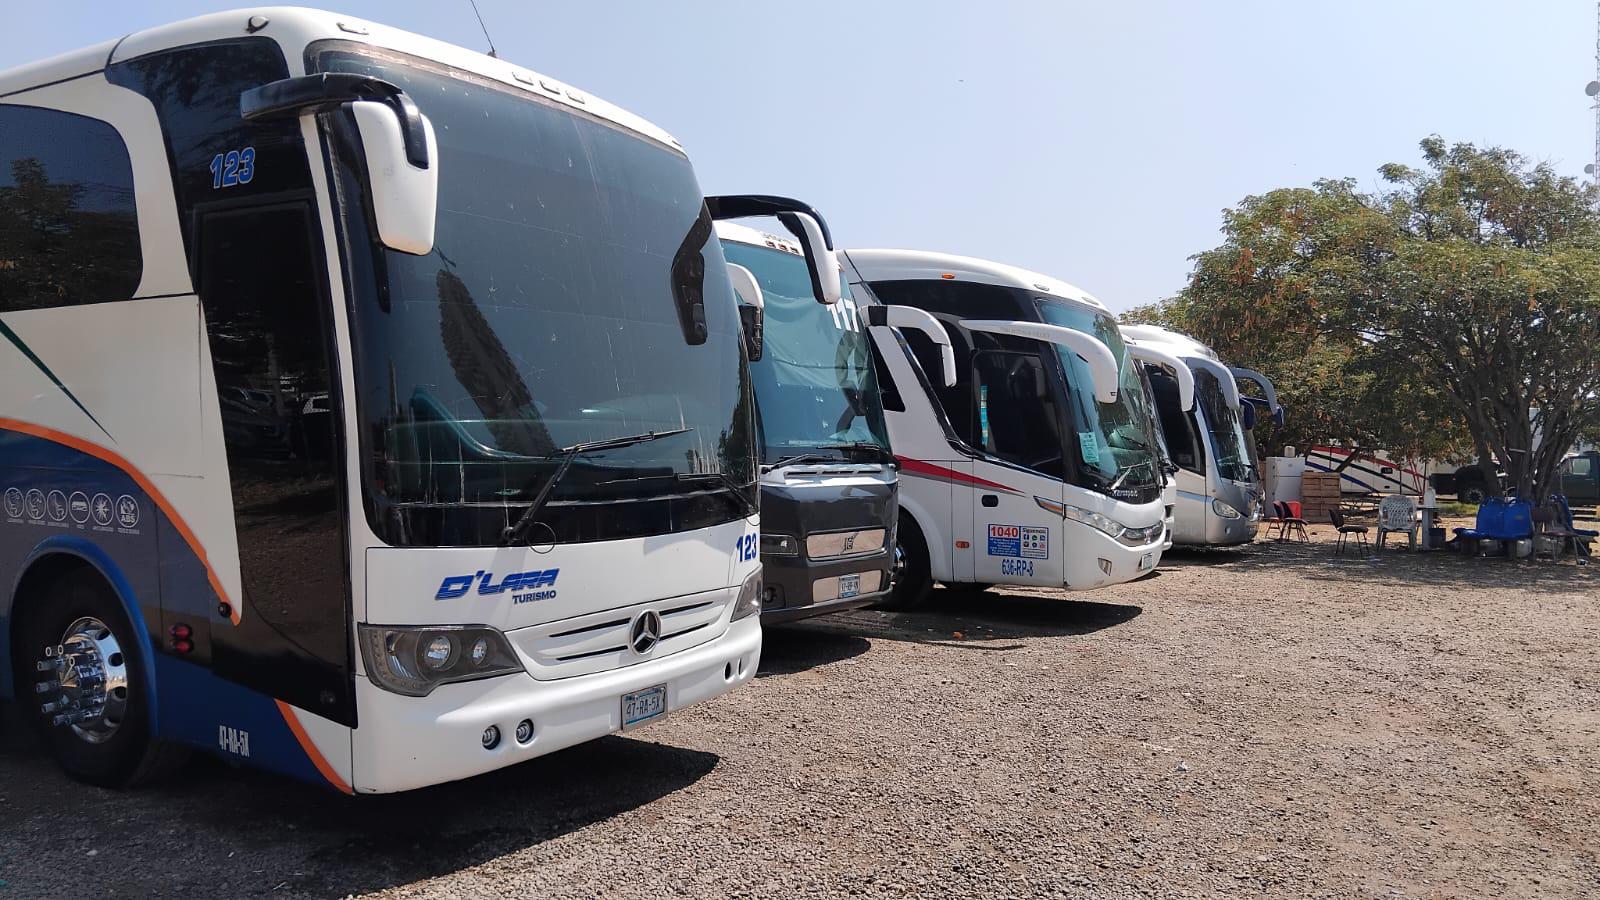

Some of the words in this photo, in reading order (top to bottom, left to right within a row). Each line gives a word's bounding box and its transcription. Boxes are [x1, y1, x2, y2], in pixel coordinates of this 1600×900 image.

[210, 147, 255, 189] 123
[826, 297, 859, 333] 117
[121, 513, 136, 524] ABS
[991, 526, 1018, 538] 1040
[736, 533, 757, 562] 123
[1002, 559, 1034, 577] 636-RP-8
[435, 568, 559, 601] D'LARA
[512, 589, 556, 605] TURISMO
[626, 695, 662, 717] 47-RA-5X
[219, 725, 250, 757] 47-RA-5X
